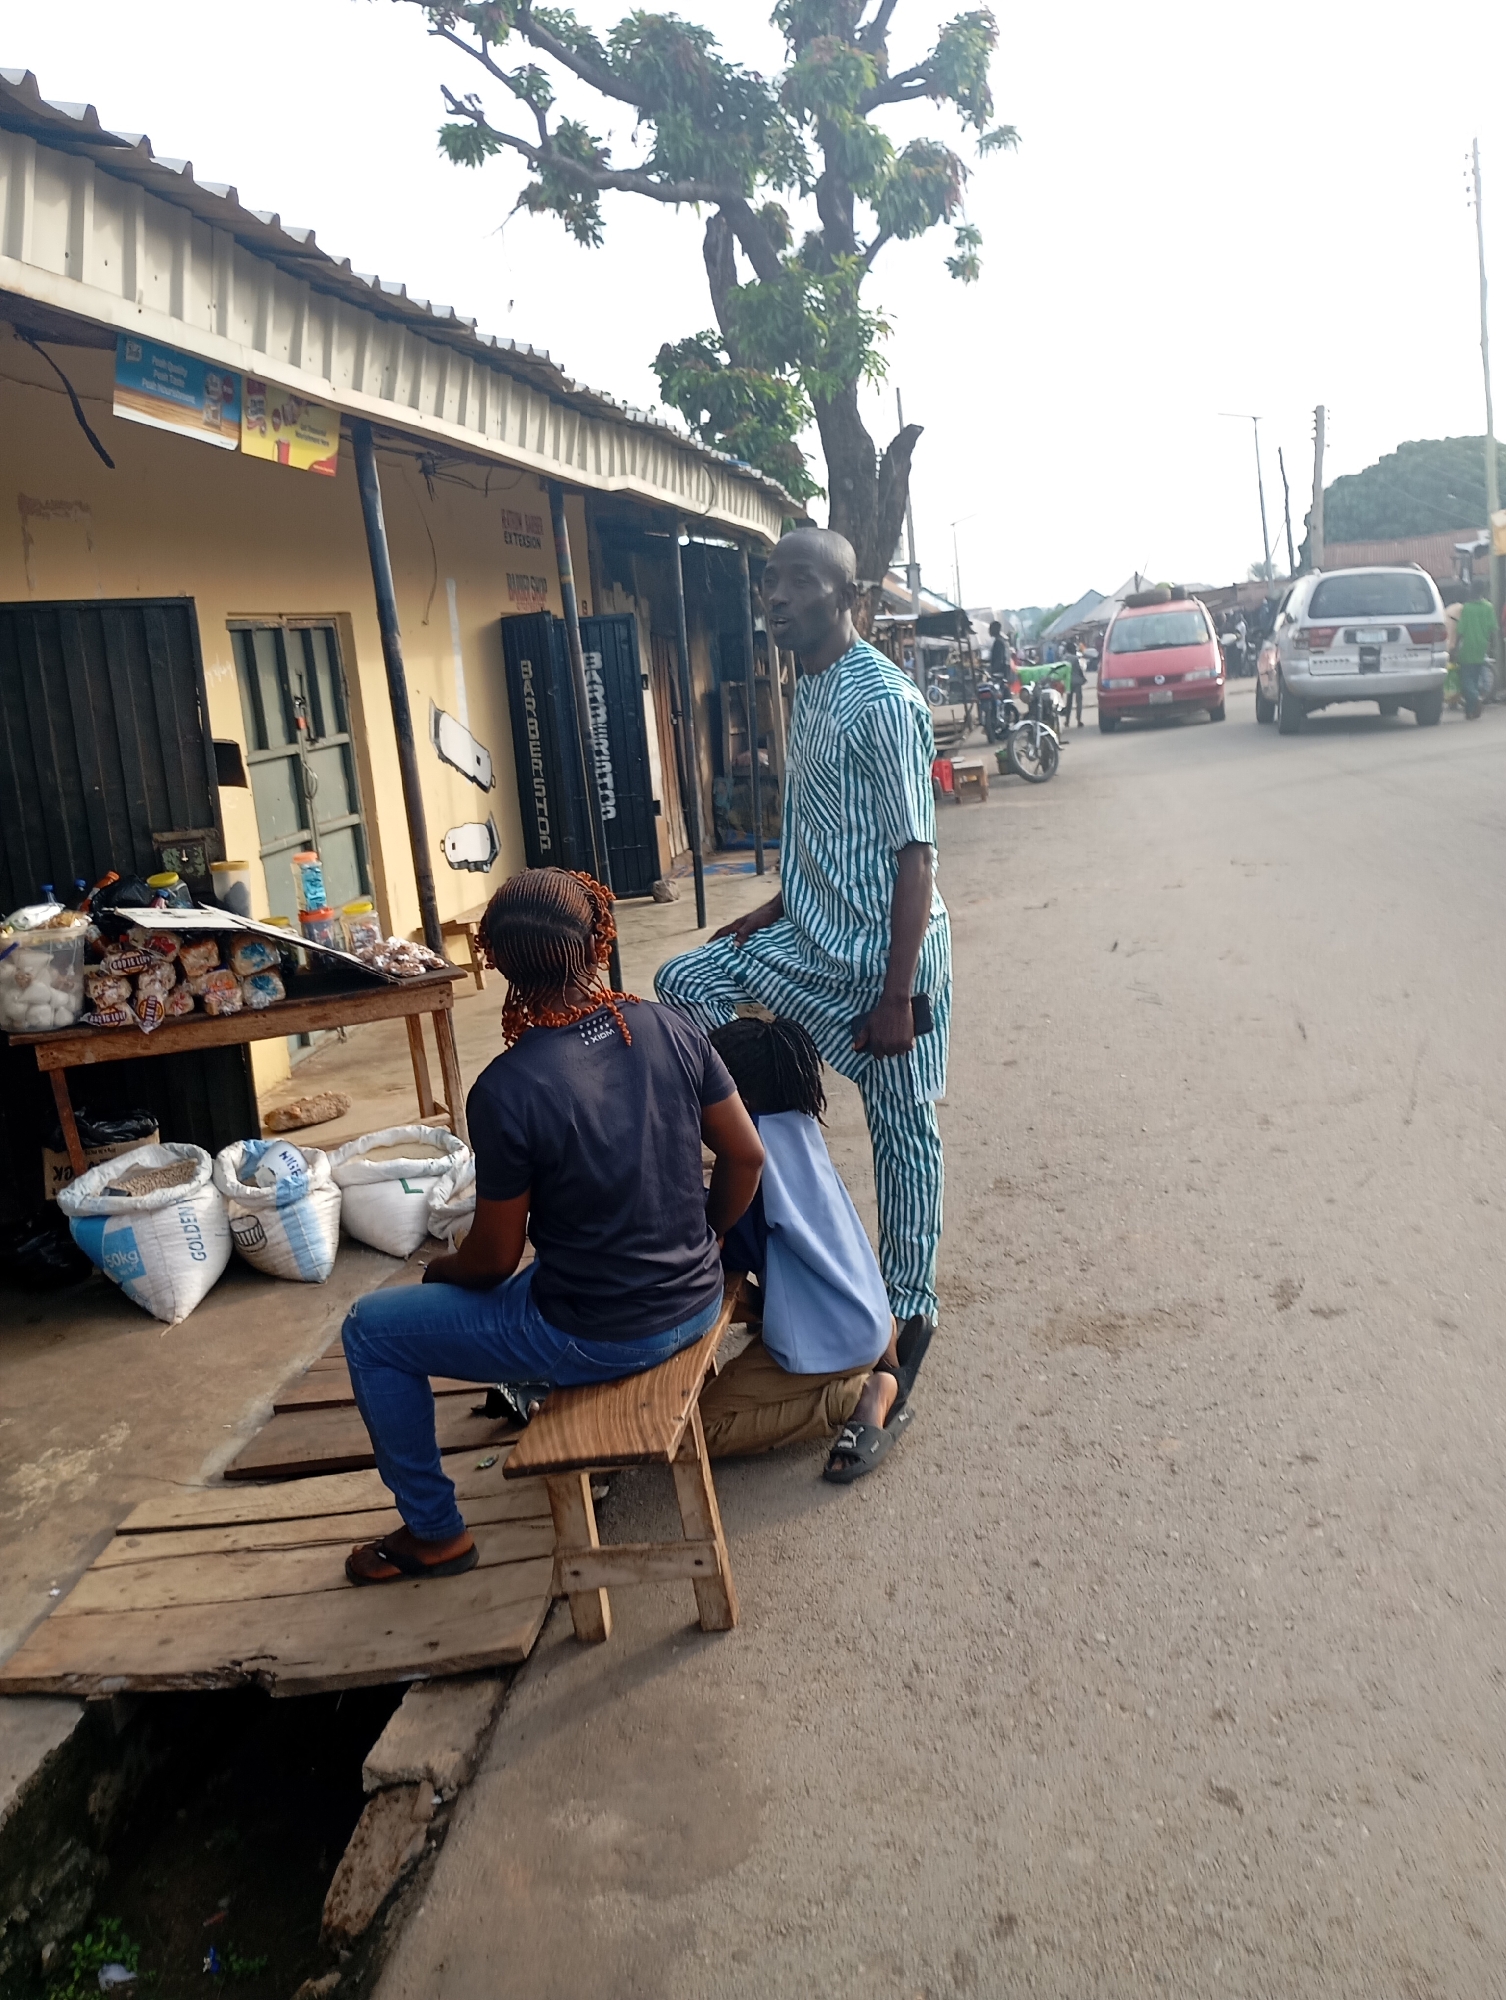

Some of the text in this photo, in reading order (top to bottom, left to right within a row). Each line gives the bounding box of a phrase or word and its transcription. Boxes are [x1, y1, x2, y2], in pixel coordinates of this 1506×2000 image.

[520, 660, 552, 855] BARBERSHOP
[589, 1028, 616, 1044] XIOM
[177, 1206, 207, 1262] GOLDEN
[105, 1250, 139, 1268] 50kg
